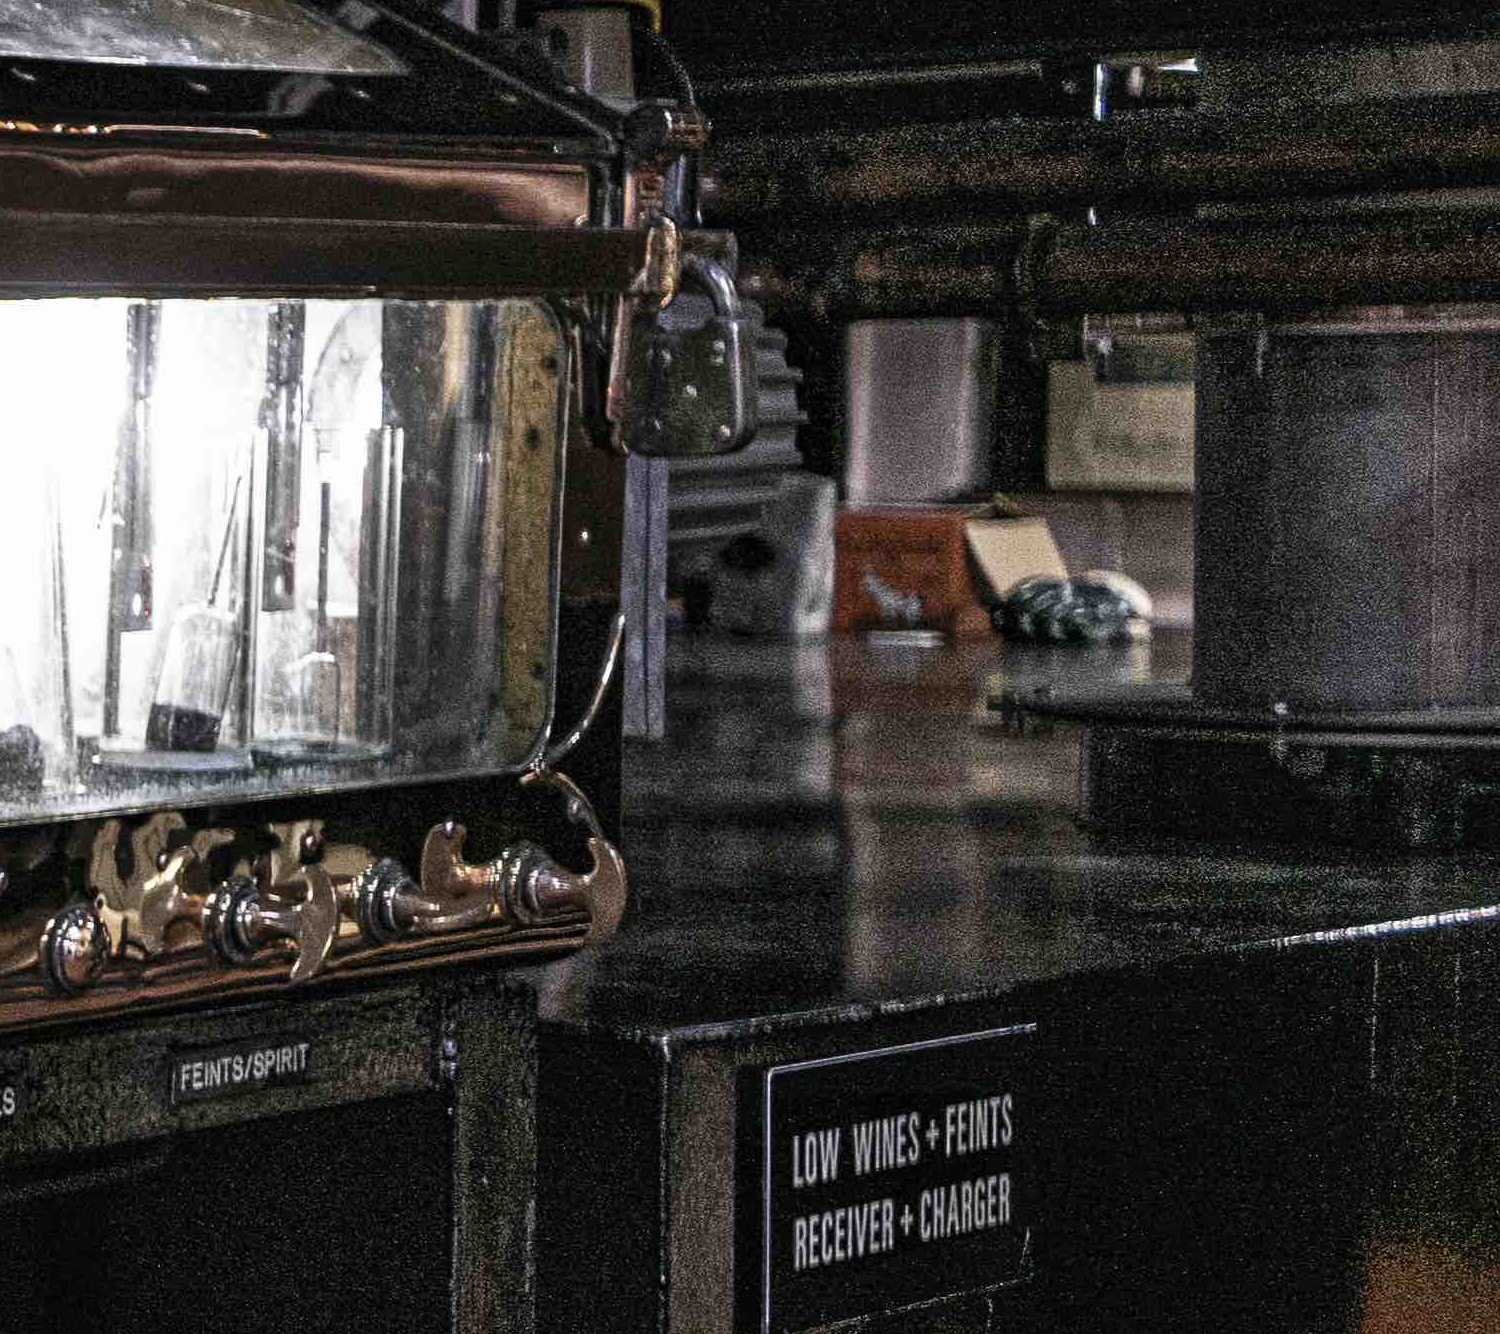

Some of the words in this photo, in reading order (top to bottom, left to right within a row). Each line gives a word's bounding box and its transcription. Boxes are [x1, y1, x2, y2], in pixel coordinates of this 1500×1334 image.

[180, 1043, 311, 1092] FEINTS/SPIRIT
[792, 1127, 841, 1188] LOW
[852, 1111, 920, 1176] WINES
[925, 1118, 940, 1151] +
[945, 1093, 1013, 1157] FEINTS
[794, 1197, 895, 1272] RECEIVER
[900, 1204, 914, 1236] +
[920, 1172, 1011, 1242] CHARGER
